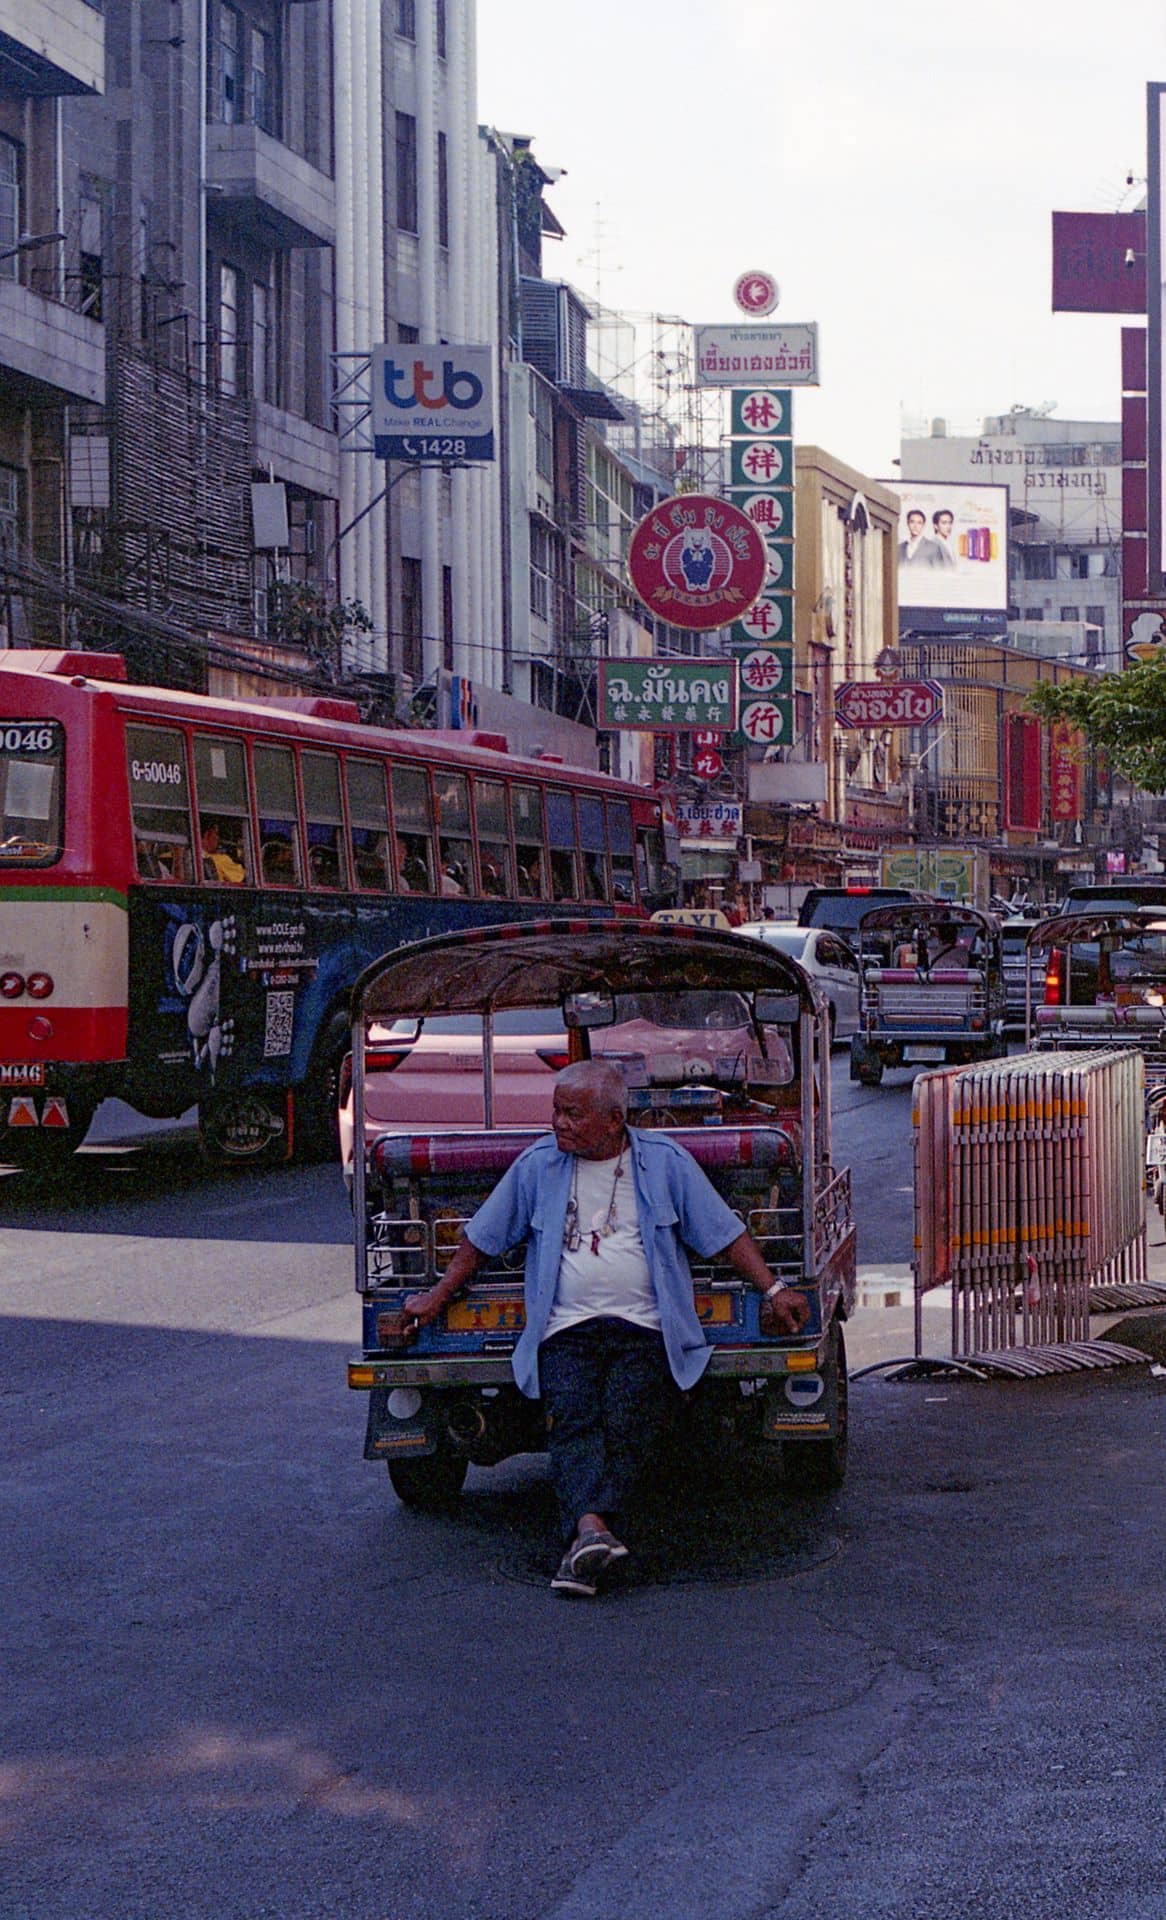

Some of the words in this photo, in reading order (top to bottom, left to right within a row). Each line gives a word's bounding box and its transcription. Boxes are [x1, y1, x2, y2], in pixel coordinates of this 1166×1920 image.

[383, 360, 483, 410] ttb
[384, 417, 410, 426] Make
[413, 417, 441, 426] REAL
[444, 418, 481, 428] Change
[420, 440, 466, 455] 1428
[608, 664, 729, 703] ฉ.มั่นคง
[132, 760, 181, 785] 6-50046
